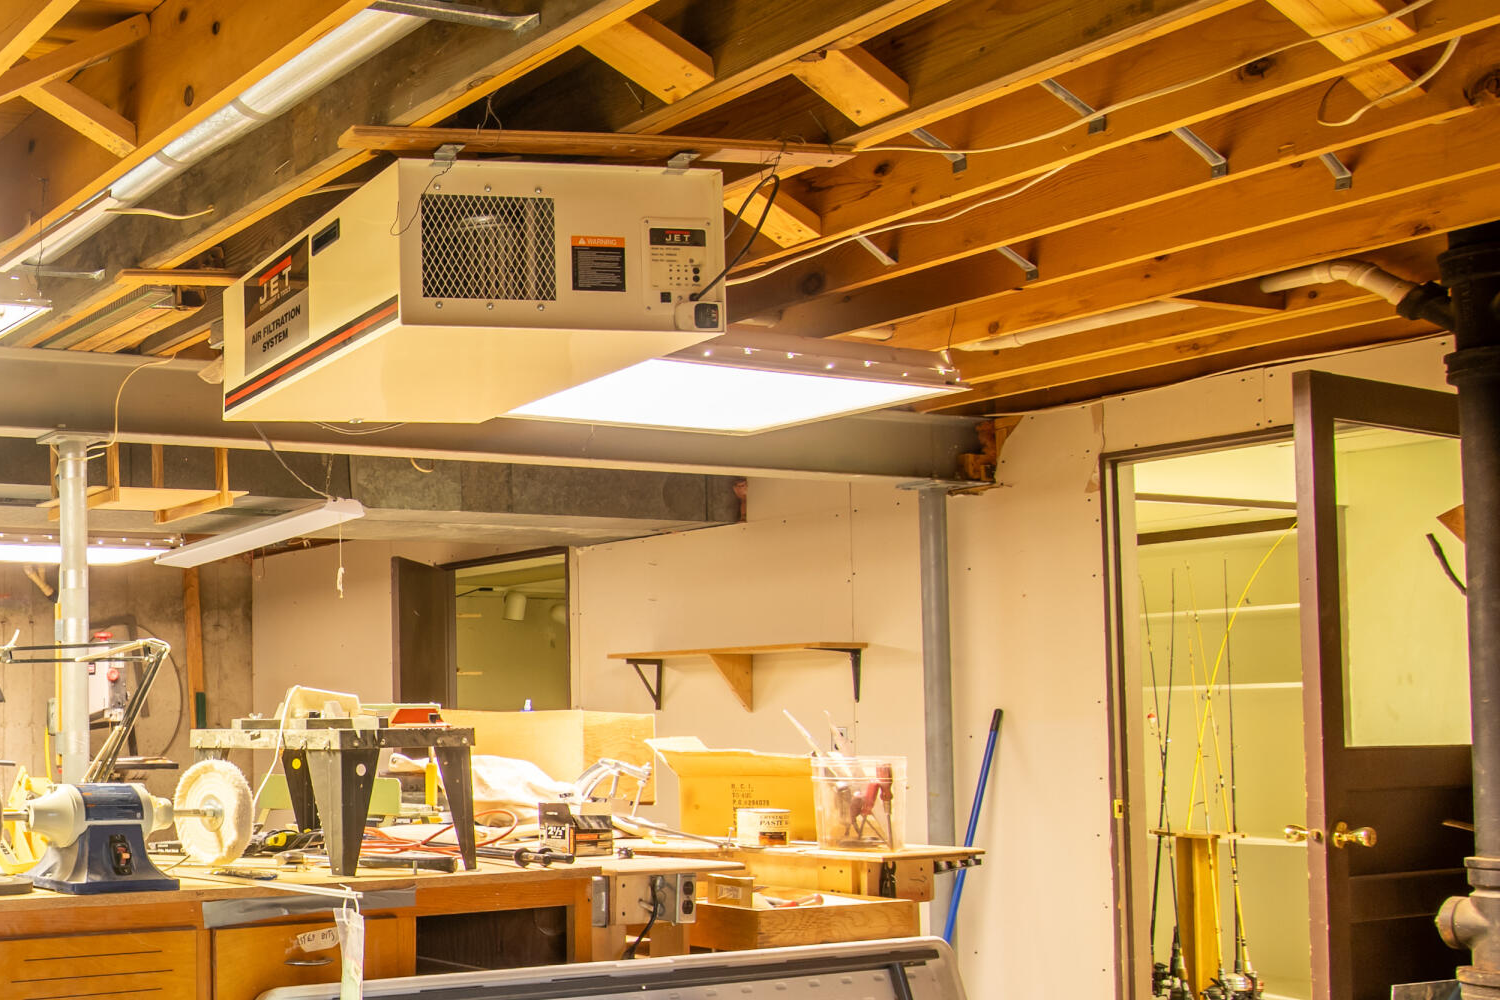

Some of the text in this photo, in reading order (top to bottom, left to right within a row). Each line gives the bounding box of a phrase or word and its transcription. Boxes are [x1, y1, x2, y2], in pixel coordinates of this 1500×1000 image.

[259, 265, 292, 305] JET
[251, 330, 262, 345] AIR
[262, 304, 301, 338] FILTRATION
[262, 328, 289, 353] SYSTEM
[321, 929, 335, 942] BITS
